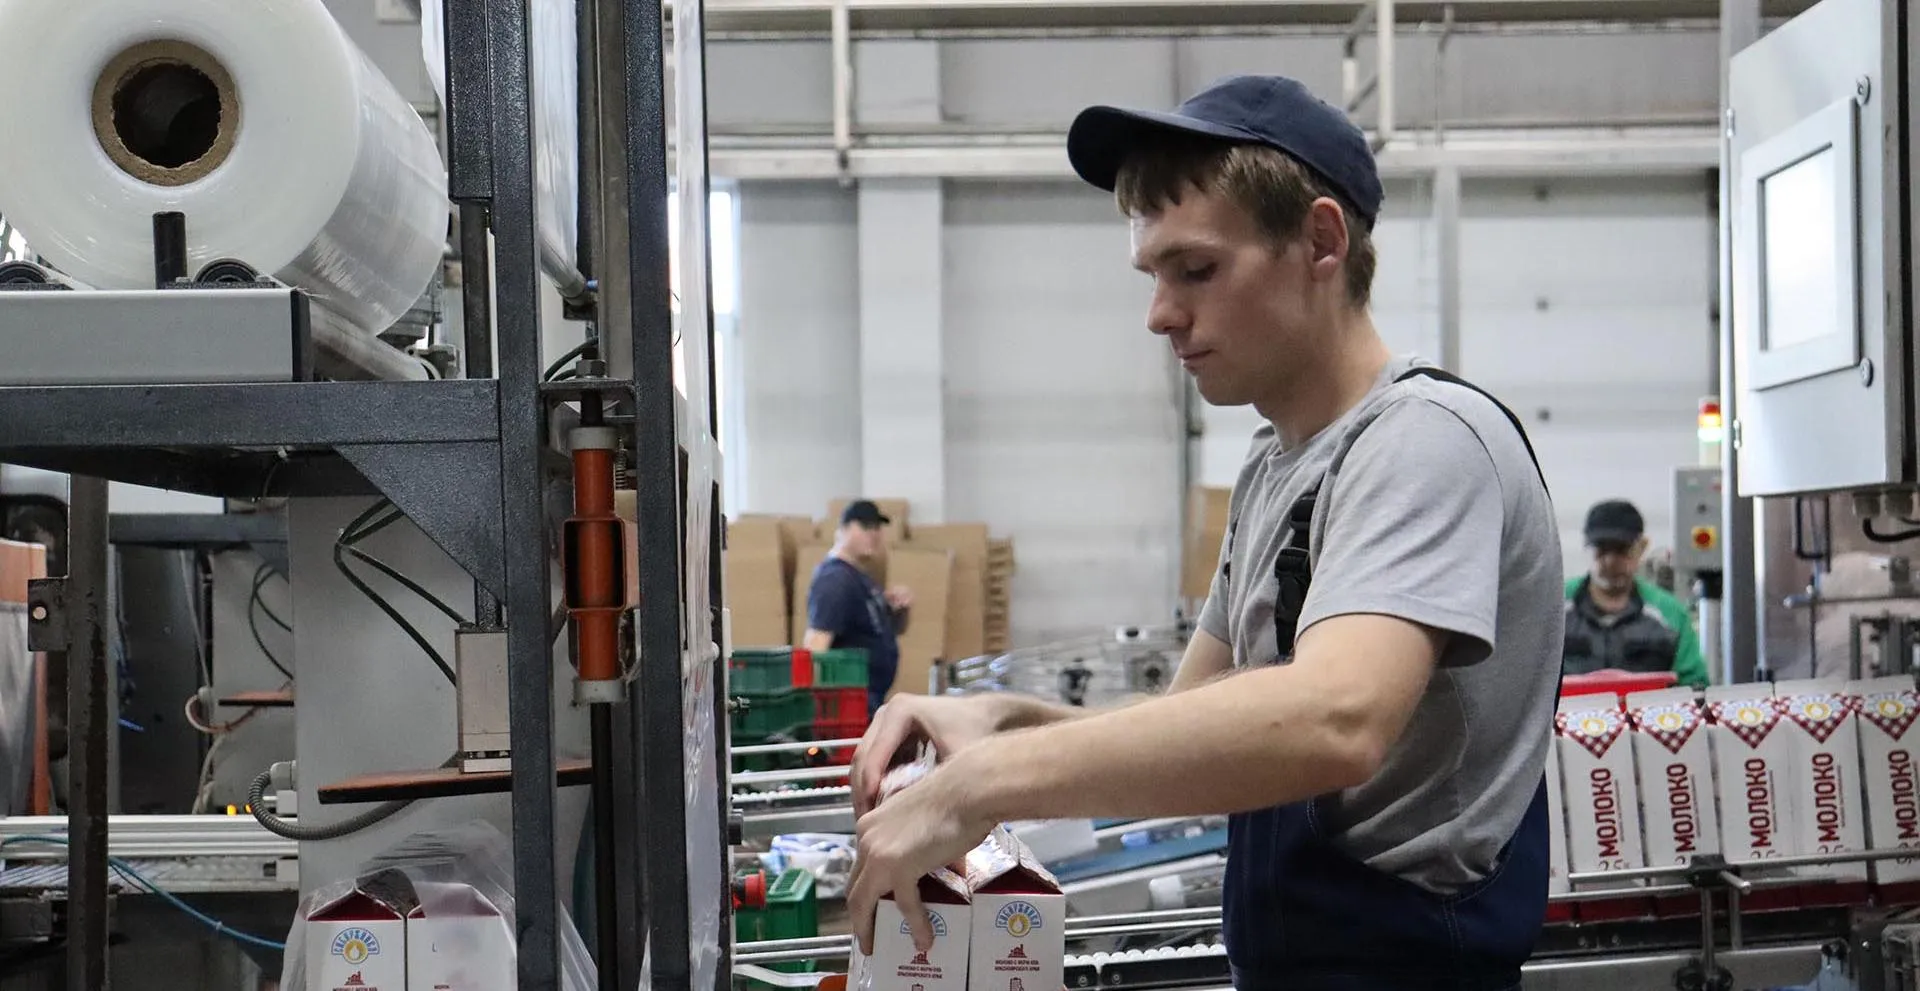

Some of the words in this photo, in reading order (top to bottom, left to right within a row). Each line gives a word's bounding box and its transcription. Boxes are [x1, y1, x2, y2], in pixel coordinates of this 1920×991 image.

[1590, 768, 1619, 857] МОЛОКО
[1667, 763, 1696, 853] МОЛОКО
[1745, 758, 1772, 848] МОЛОКО
[1812, 752, 1840, 843] МОЛОКО
[1888, 750, 1920, 839] МОЛОКО
